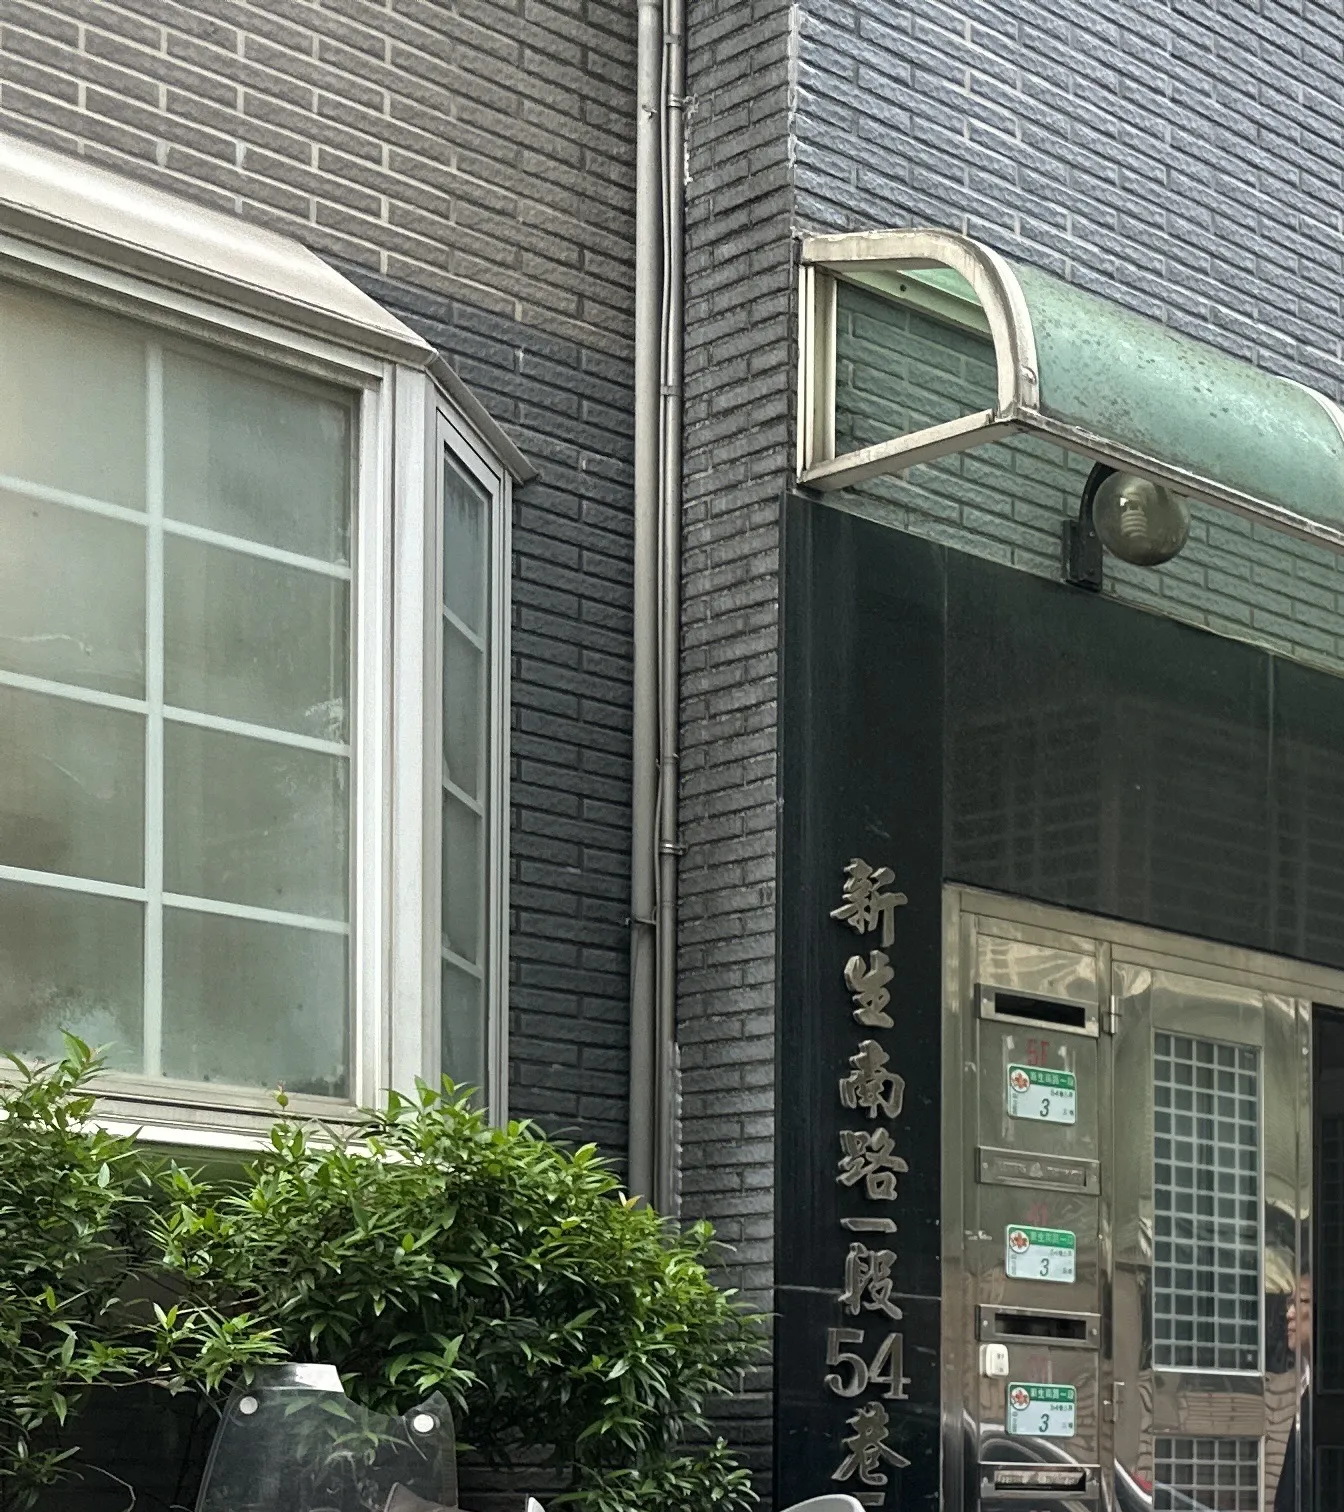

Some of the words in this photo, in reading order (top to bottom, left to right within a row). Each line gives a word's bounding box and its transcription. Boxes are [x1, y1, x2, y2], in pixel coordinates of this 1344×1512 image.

[1040, 1098, 1050, 1117] 3
[1040, 1257, 1050, 1277] 3
[1039, 1413, 1050, 1433] 3
